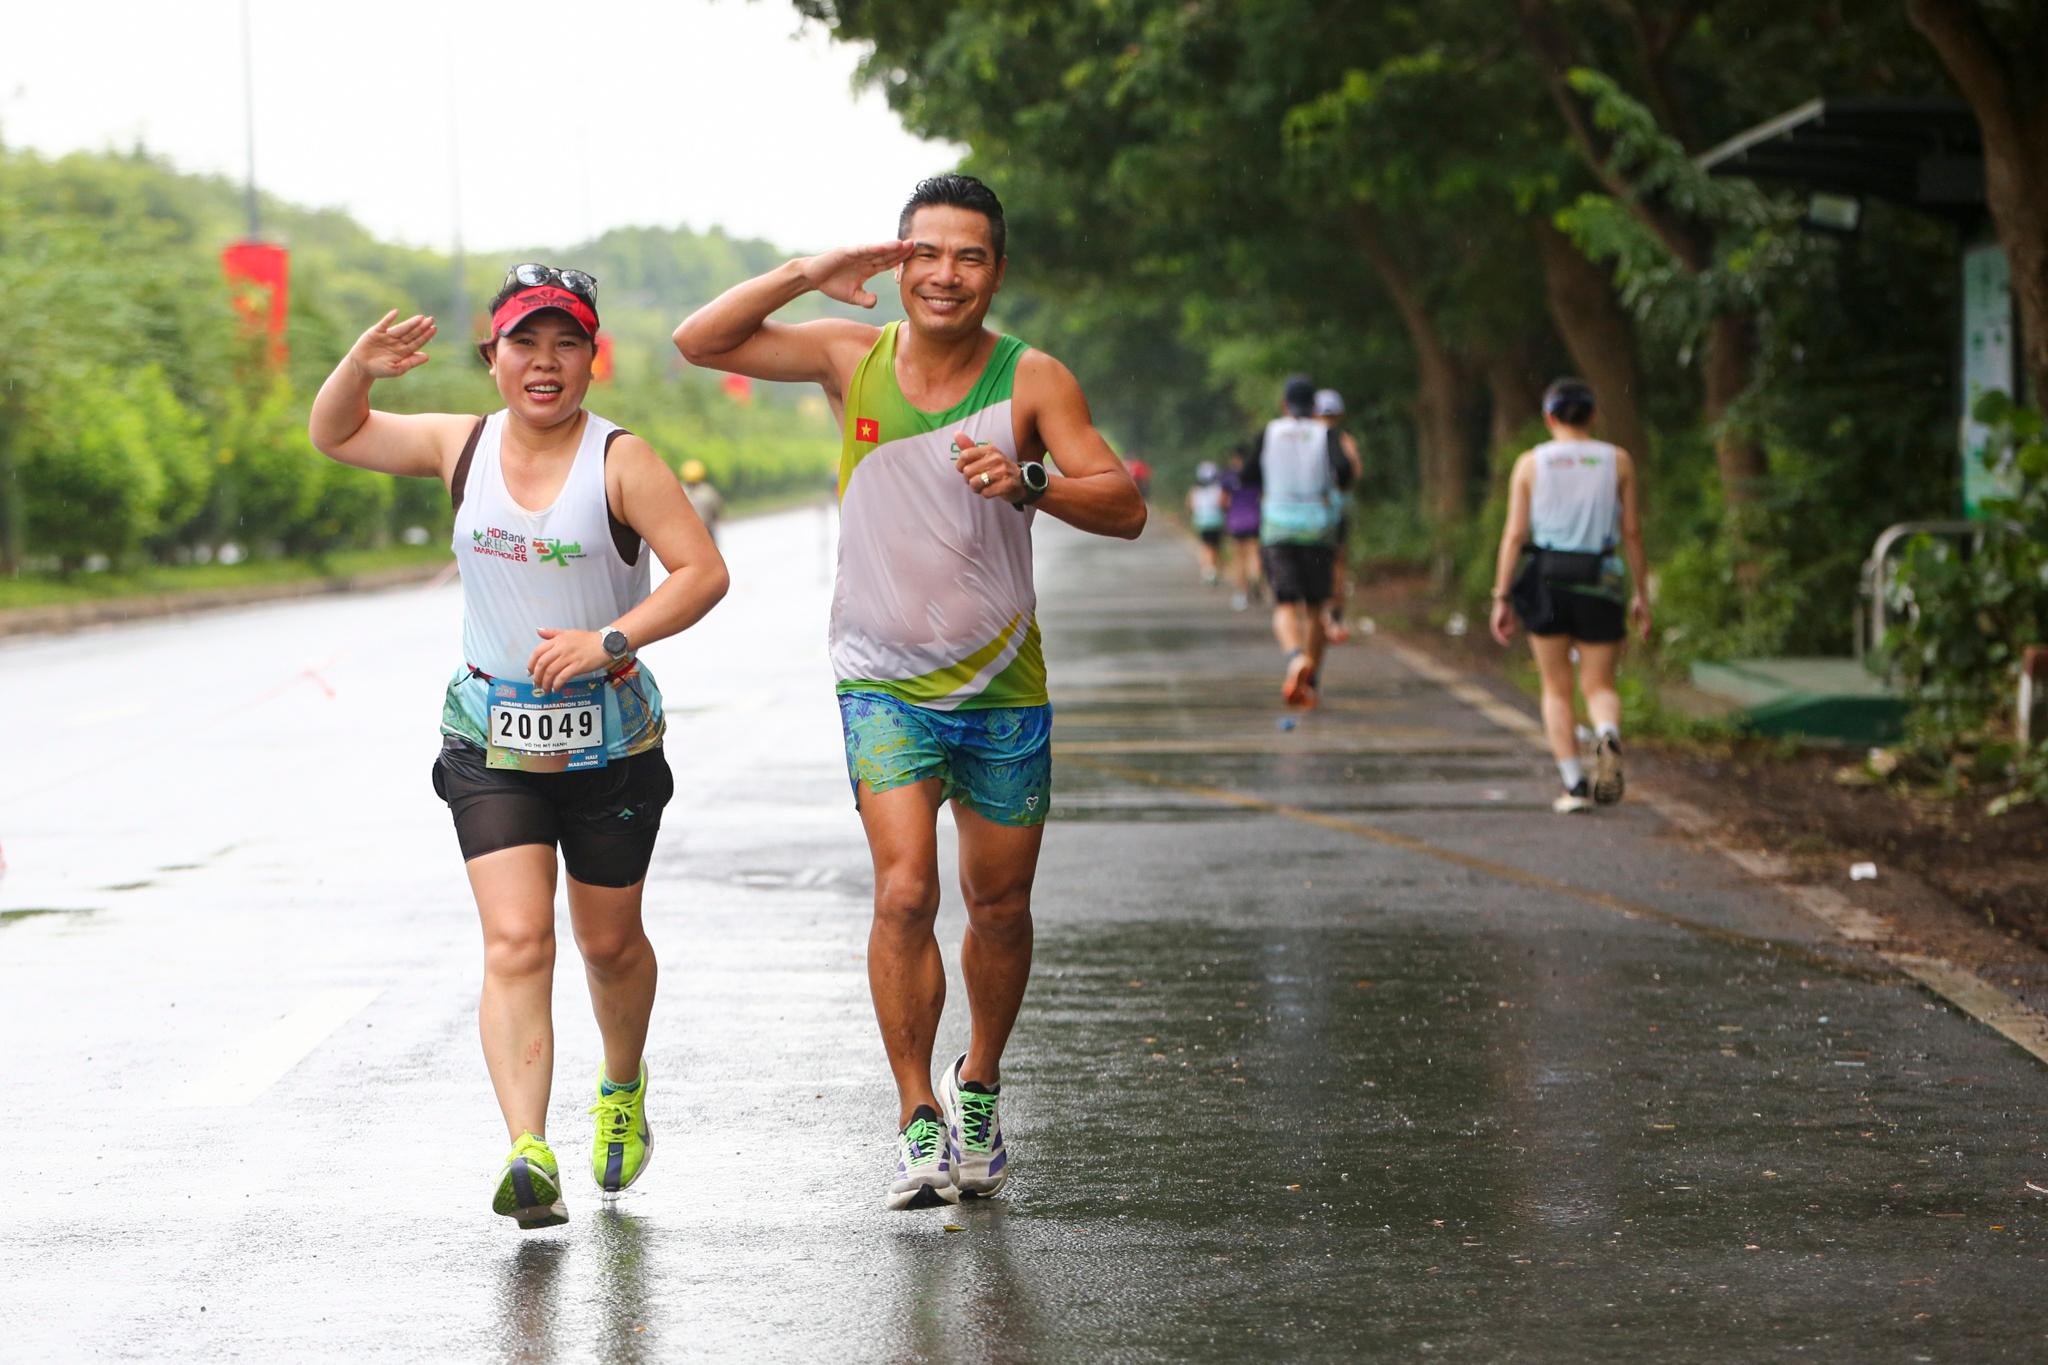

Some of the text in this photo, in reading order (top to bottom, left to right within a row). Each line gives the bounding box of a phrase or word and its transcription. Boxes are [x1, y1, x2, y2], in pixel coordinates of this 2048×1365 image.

[487, 527, 526, 544] HDBank
[474, 546, 514, 560] MARATHON
[514, 543, 526, 553] 20
[515, 553, 528, 562] 26
[543, 701, 576, 709] MARATHON
[500, 711, 592, 740] 20049
